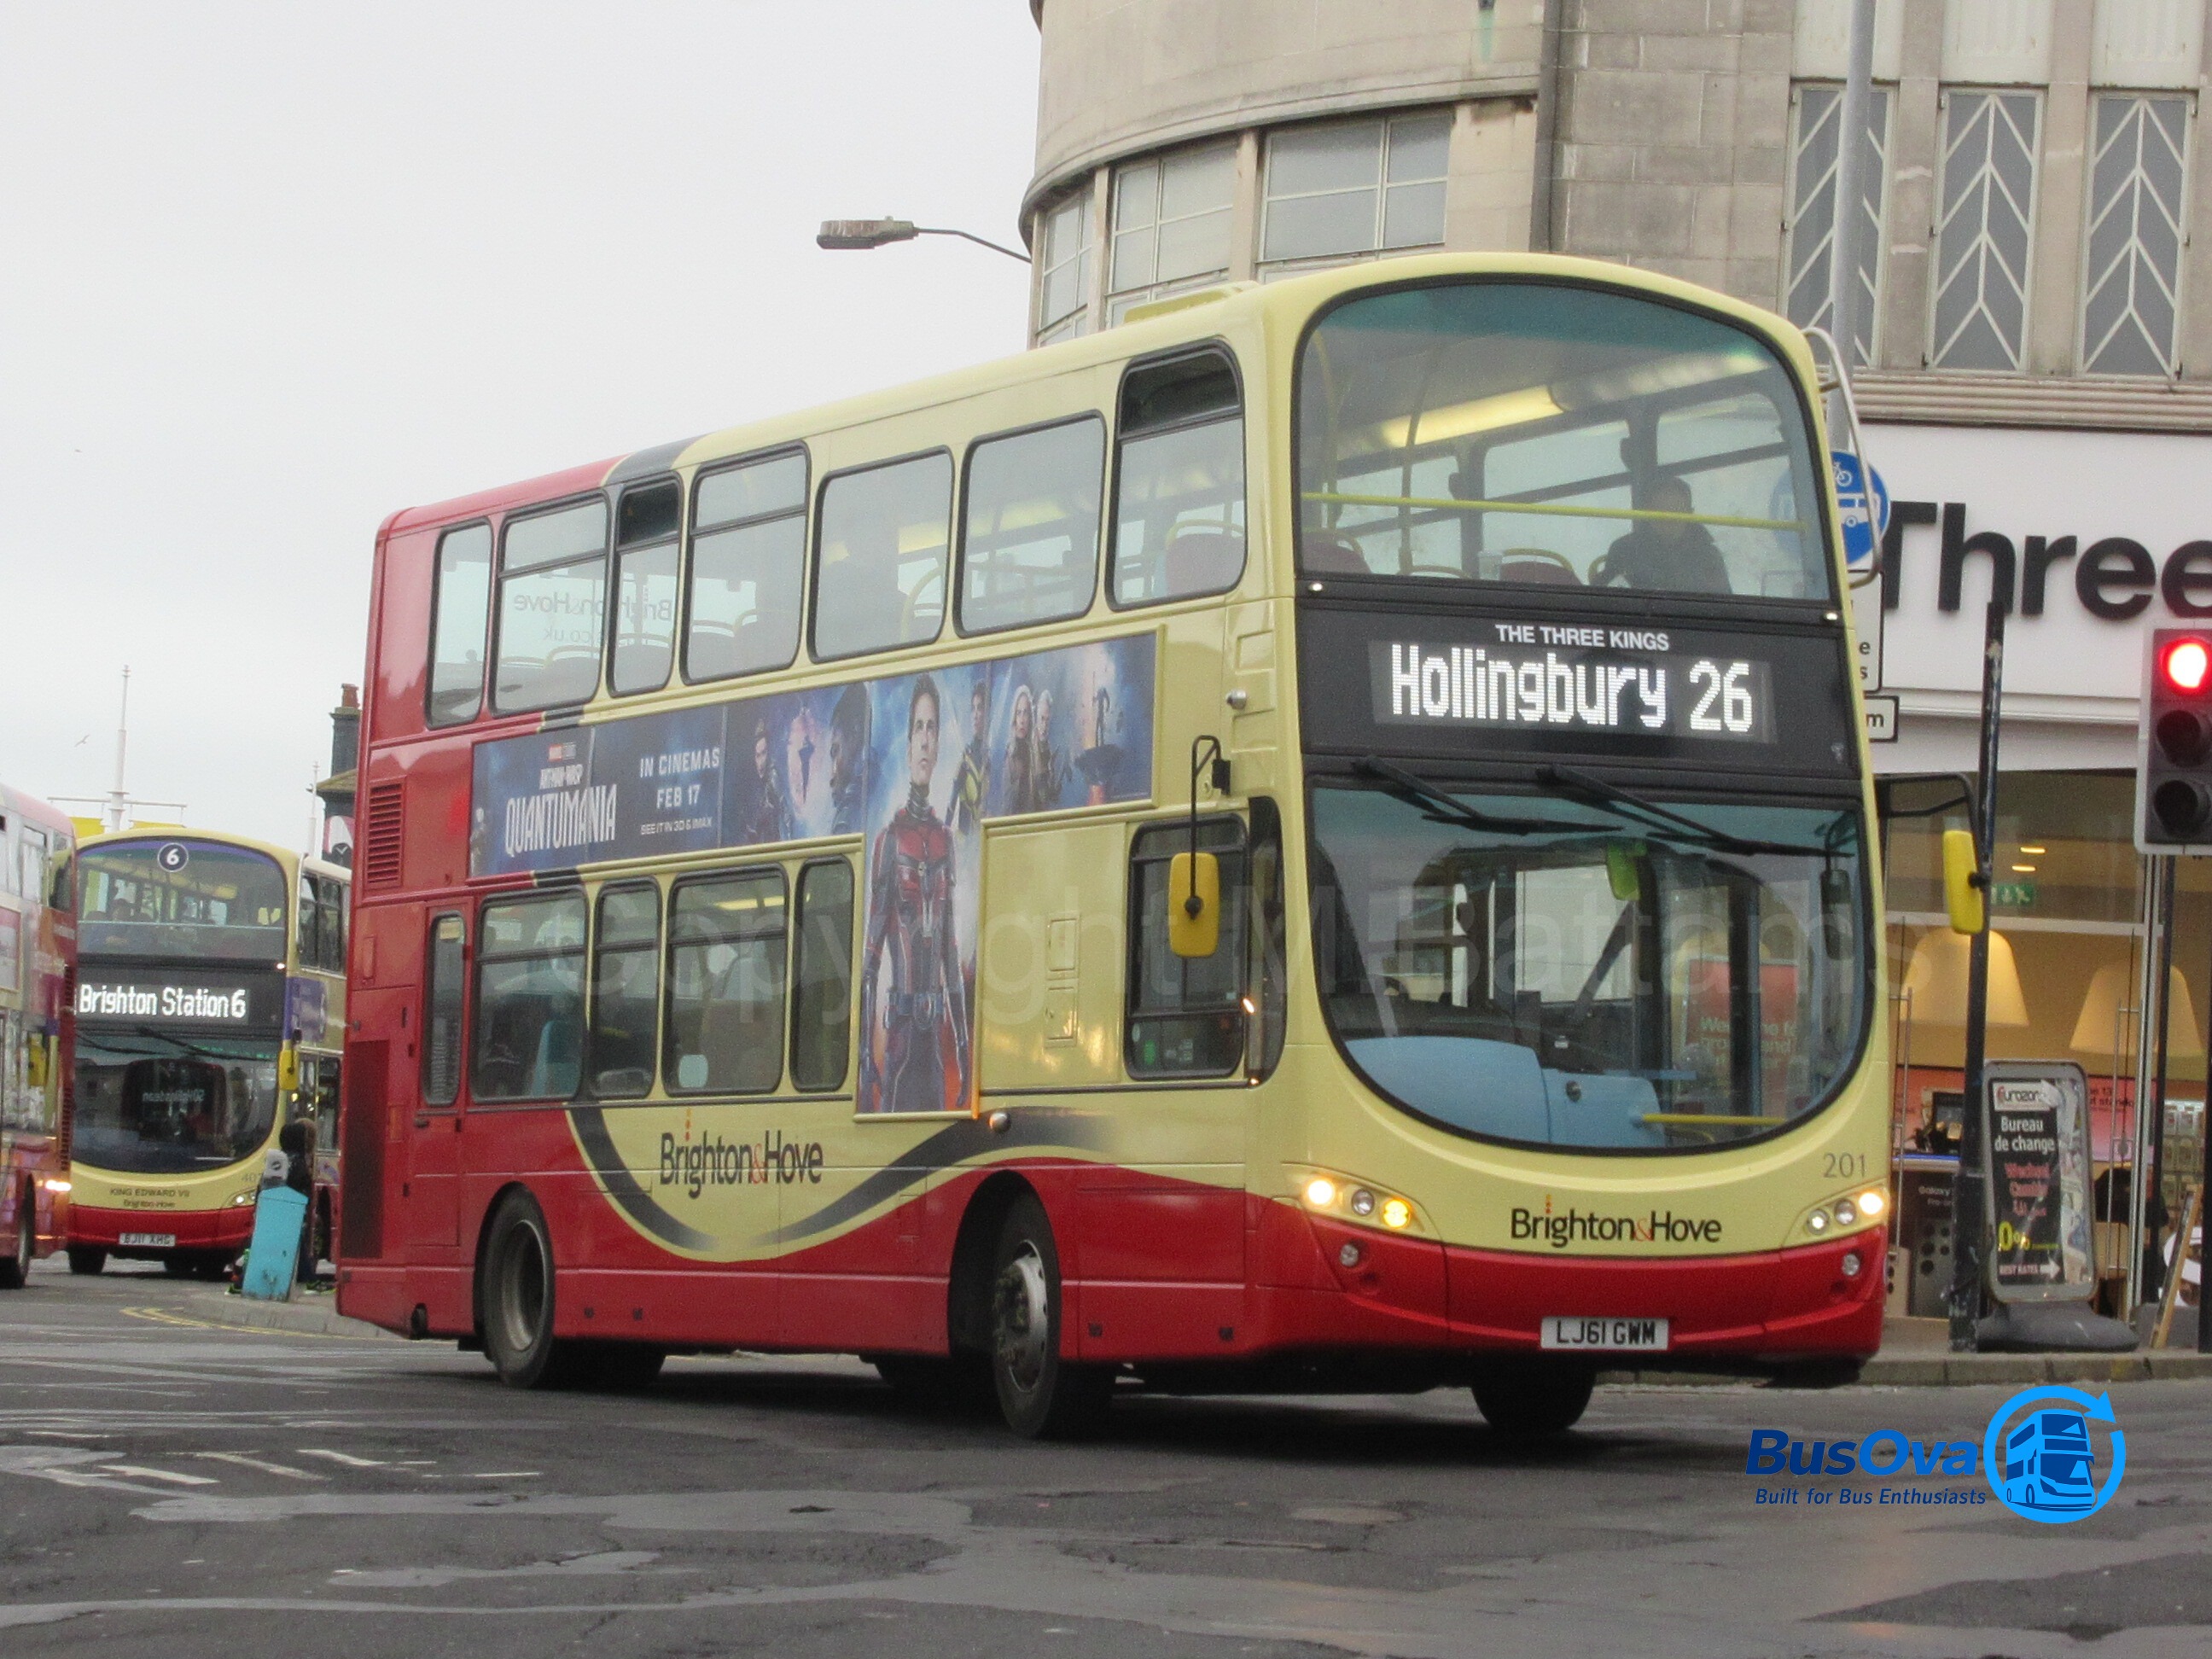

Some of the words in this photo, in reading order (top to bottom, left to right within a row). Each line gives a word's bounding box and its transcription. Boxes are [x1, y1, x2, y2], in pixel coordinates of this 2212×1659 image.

[1882, 500, 2212, 621] Three
[1495, 625, 1535, 644] THE
[1540, 626, 1605, 648] THREE
[1610, 632, 1669, 651] KINGS
[1392, 644, 1667, 728] Hollingbury
[1690, 661, 1753, 732] 26
[640, 758, 654, 778] IN
[659, 747, 720, 777] CINEMAS
[656, 785, 682, 809] FEB
[688, 784, 701, 806] 17
[505, 783, 617, 858] QUANTUMANIA
[166, 848, 179, 865] 6
[79, 984, 158, 1016] Brighton
[162, 987, 229, 1018] Station
[231, 989, 247, 1018] 6
[2001, 1115, 2044, 1132] Bureau
[1994, 1135, 2009, 1151] de
[2011, 1135, 2055, 1155] change
[1823, 1152, 1867, 1179] 201
[135, 1188, 176, 1197] EDWARD
[1556, 1320, 1607, 1346] LJ61
[1612, 1321, 1656, 1345] GWM
